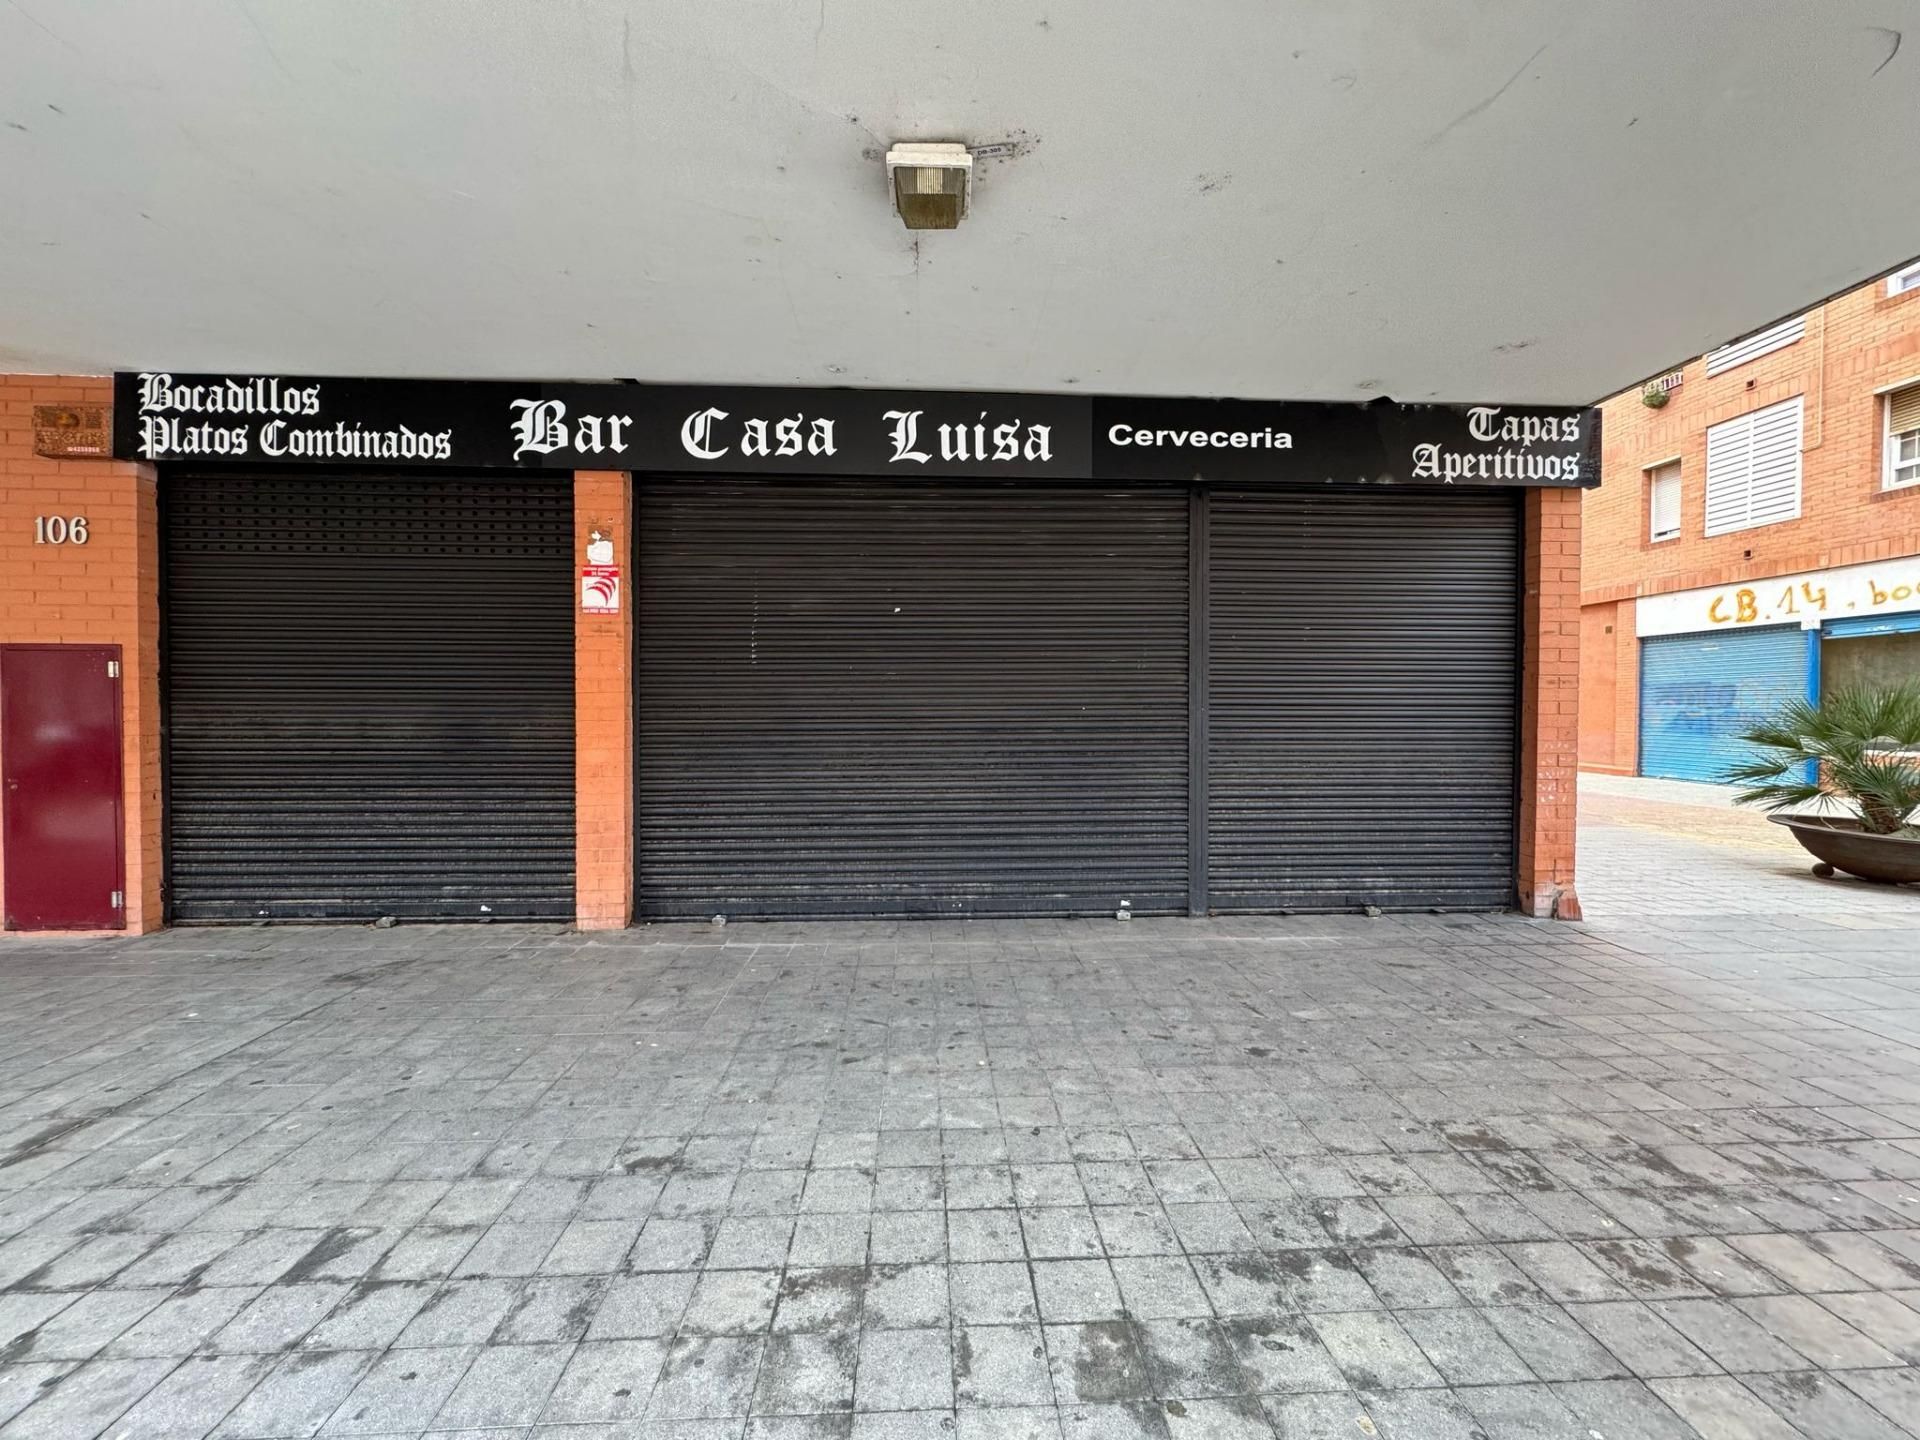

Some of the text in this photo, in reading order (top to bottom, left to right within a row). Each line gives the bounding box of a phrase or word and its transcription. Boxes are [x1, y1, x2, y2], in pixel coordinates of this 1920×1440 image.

[138, 373, 320, 415] Bocadillos
[138, 416, 452, 460] Platos Combinados
[510, 399, 1053, 464] Bar Casa Luisa
[1108, 424, 1293, 449] Cerveceria
[1466, 406, 1581, 447] Tapas
[1411, 440, 1581, 485] Aperitivos
[35, 516, 88, 544] 106
